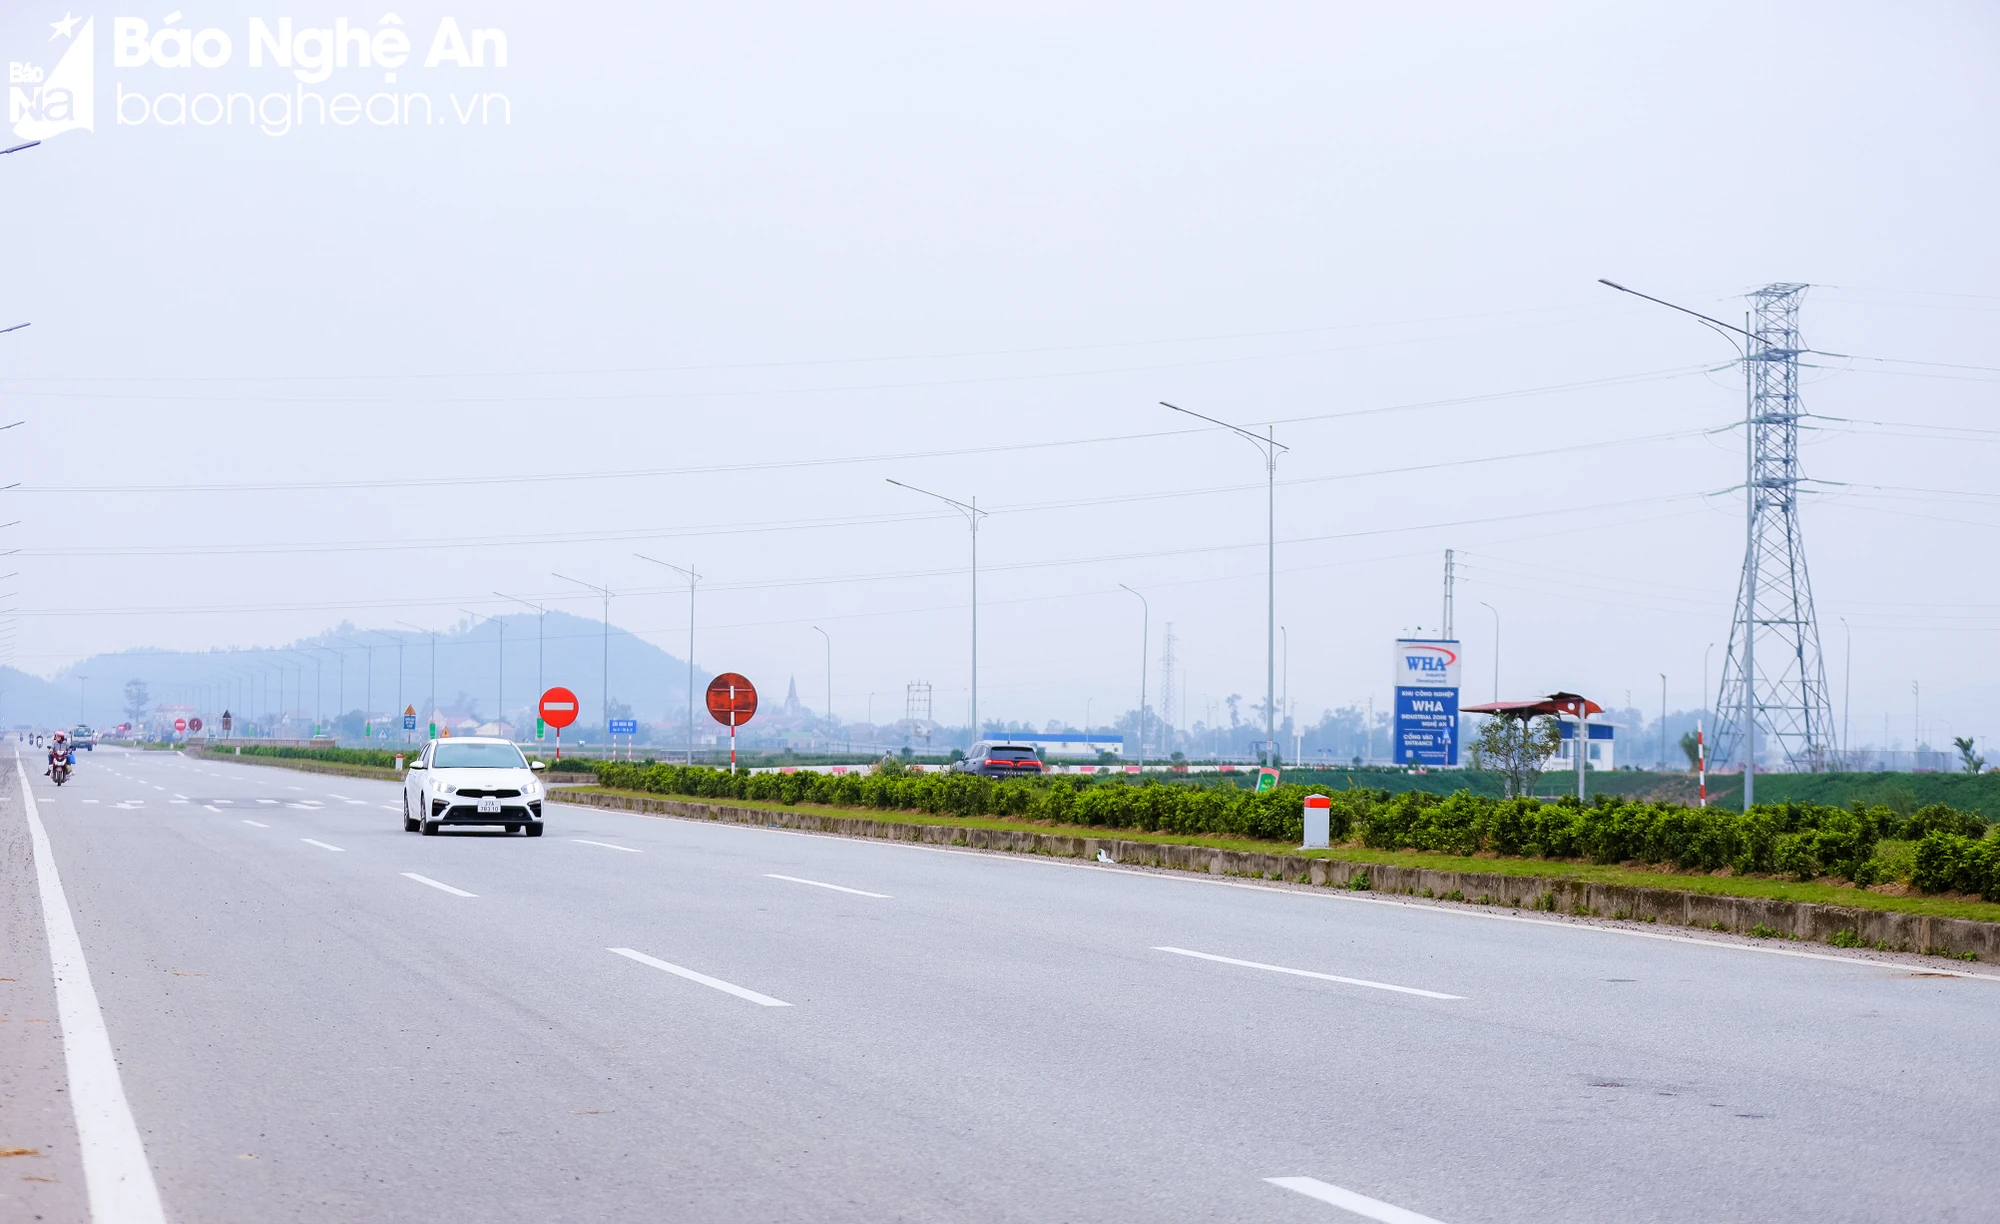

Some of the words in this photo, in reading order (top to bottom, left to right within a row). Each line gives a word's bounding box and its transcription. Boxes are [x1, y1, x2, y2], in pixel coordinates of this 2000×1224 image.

[1406, 656, 1446, 671] WHA
[1412, 700, 1444, 712] WHA
[1448, 715, 1455, 728] 1
